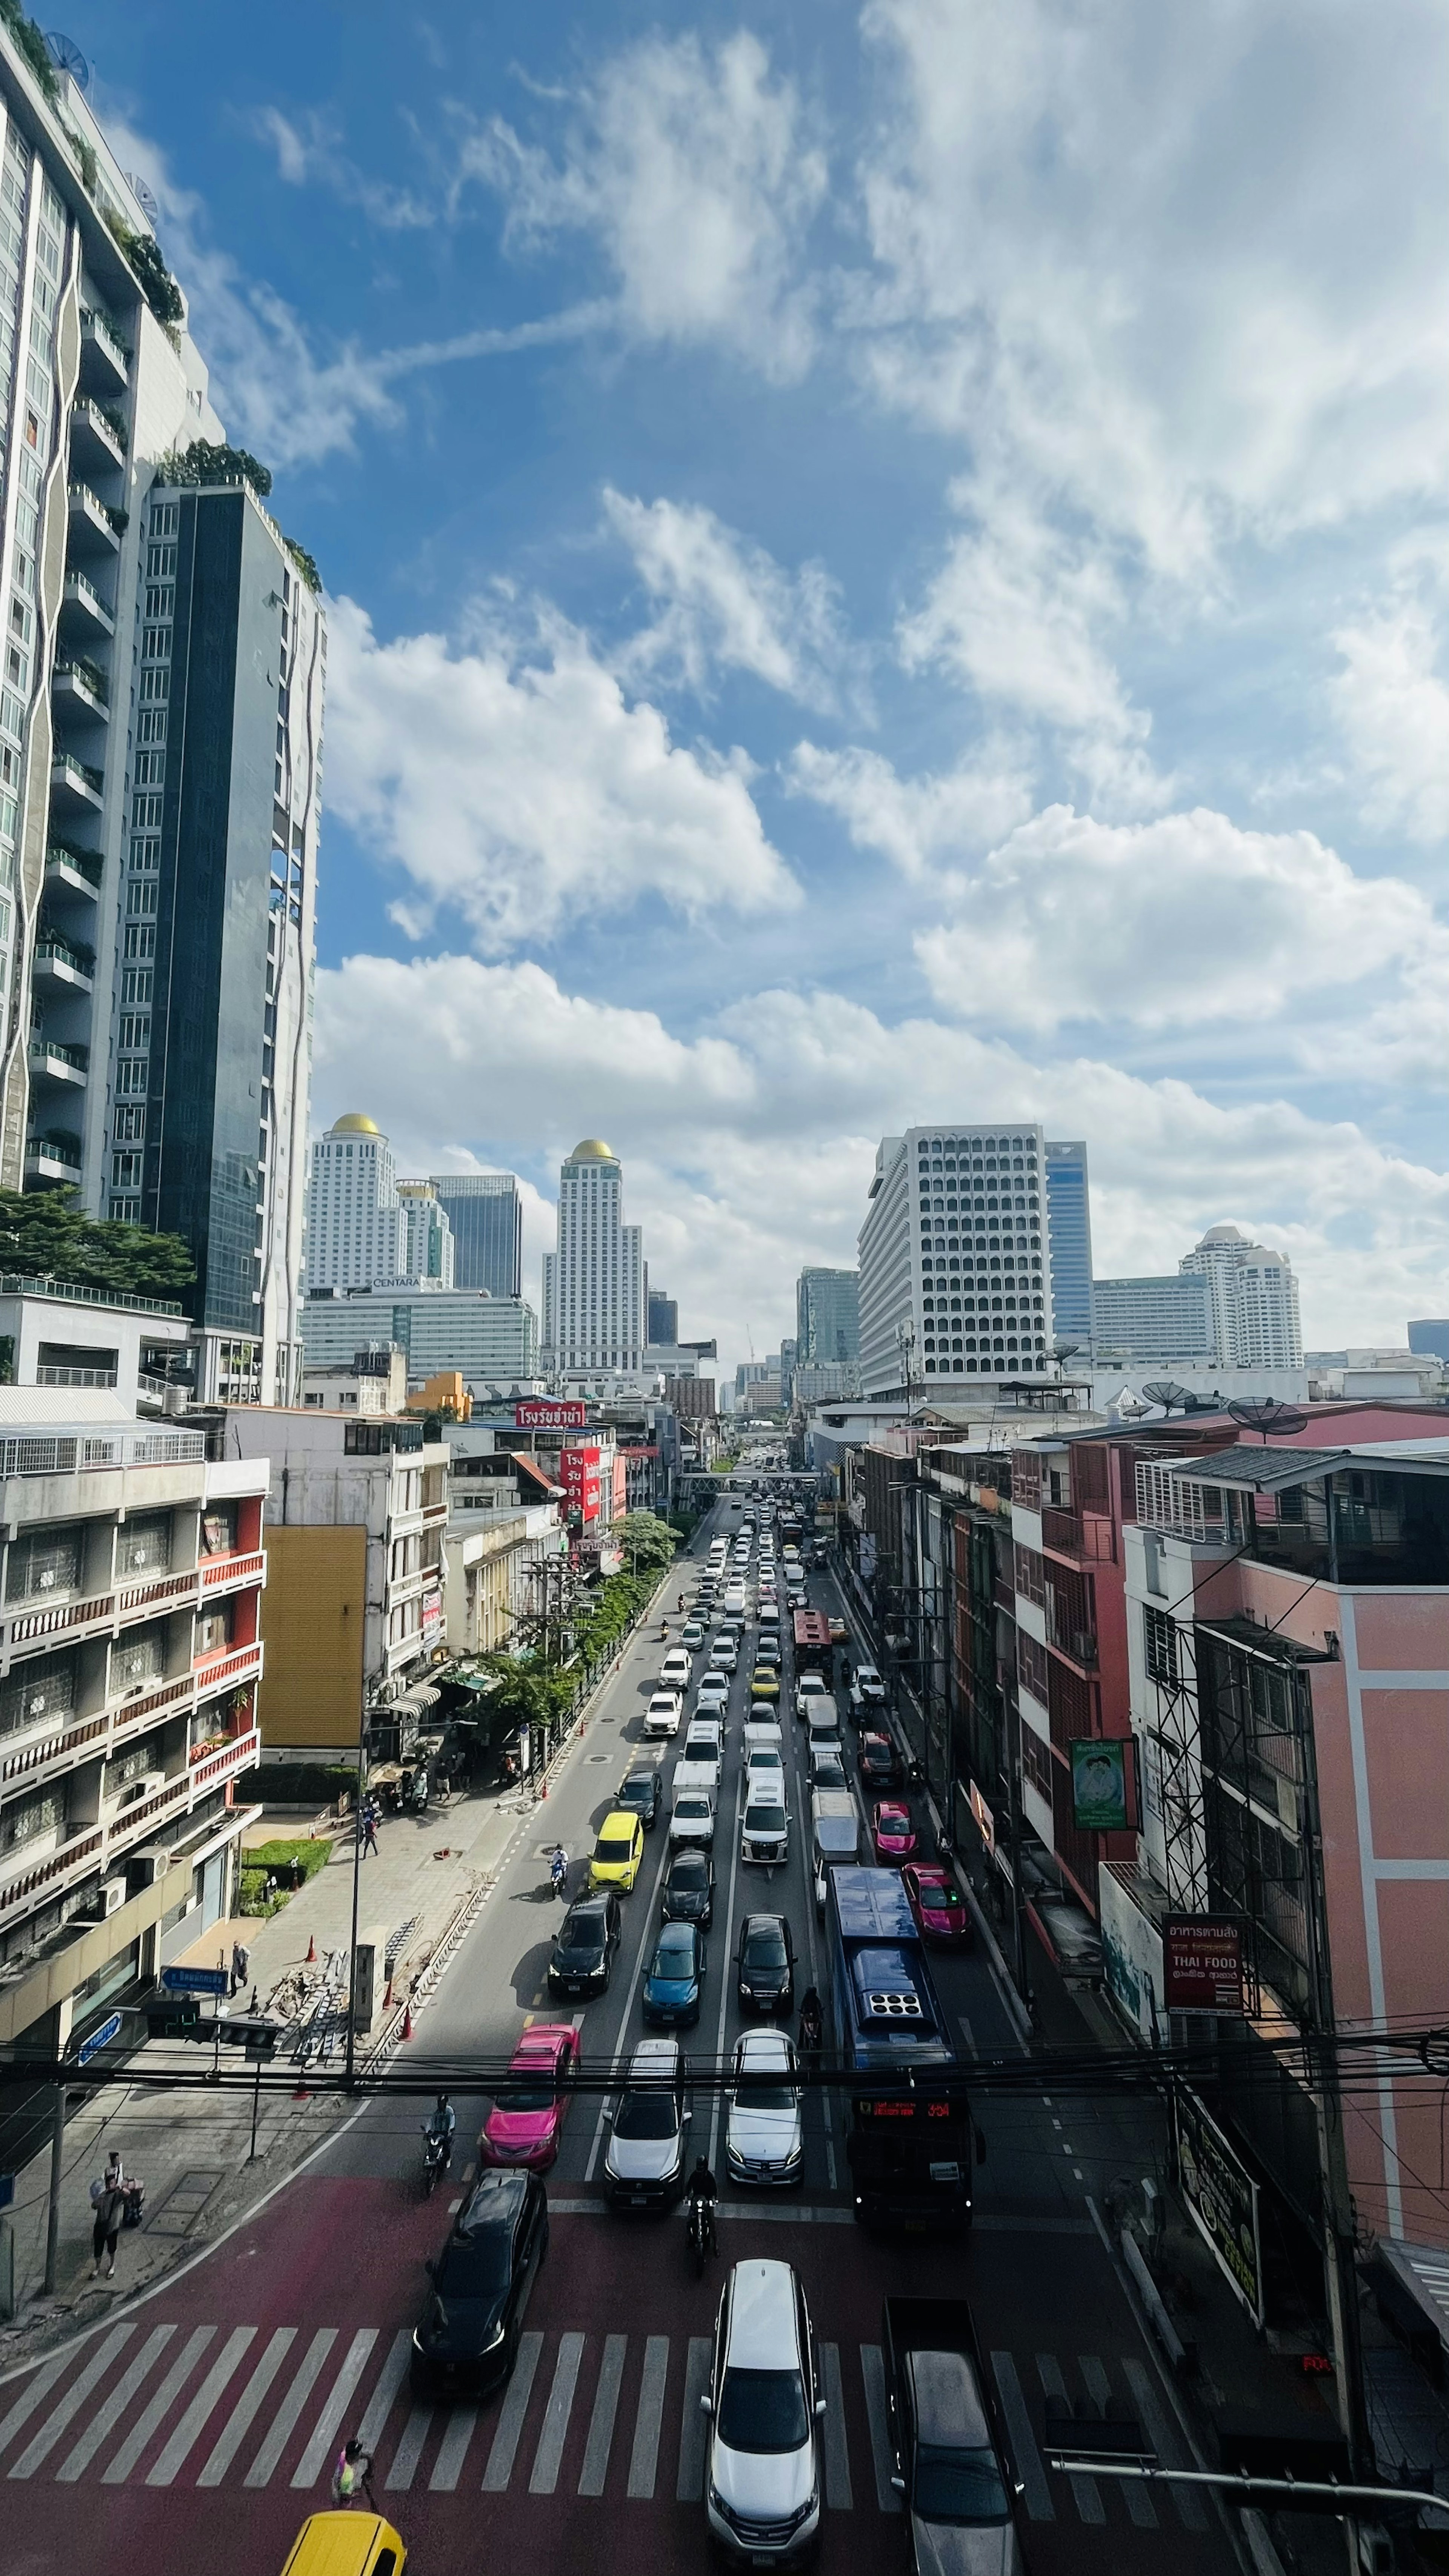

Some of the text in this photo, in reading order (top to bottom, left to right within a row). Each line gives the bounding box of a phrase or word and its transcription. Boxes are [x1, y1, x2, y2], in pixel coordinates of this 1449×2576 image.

[374, 1278, 420, 1287] CENTARA
[518, 1406, 581, 1424] โรงรับจำนำ
[566, 1454, 583, 1465] โรง
[567, 1470, 581, 1481] รับ
[568, 1485, 581, 1496] จำ
[1170, 1924, 1238, 1938] อาหารตามสั่ง
[1173, 1956, 1237, 1969] THAI FOOD
